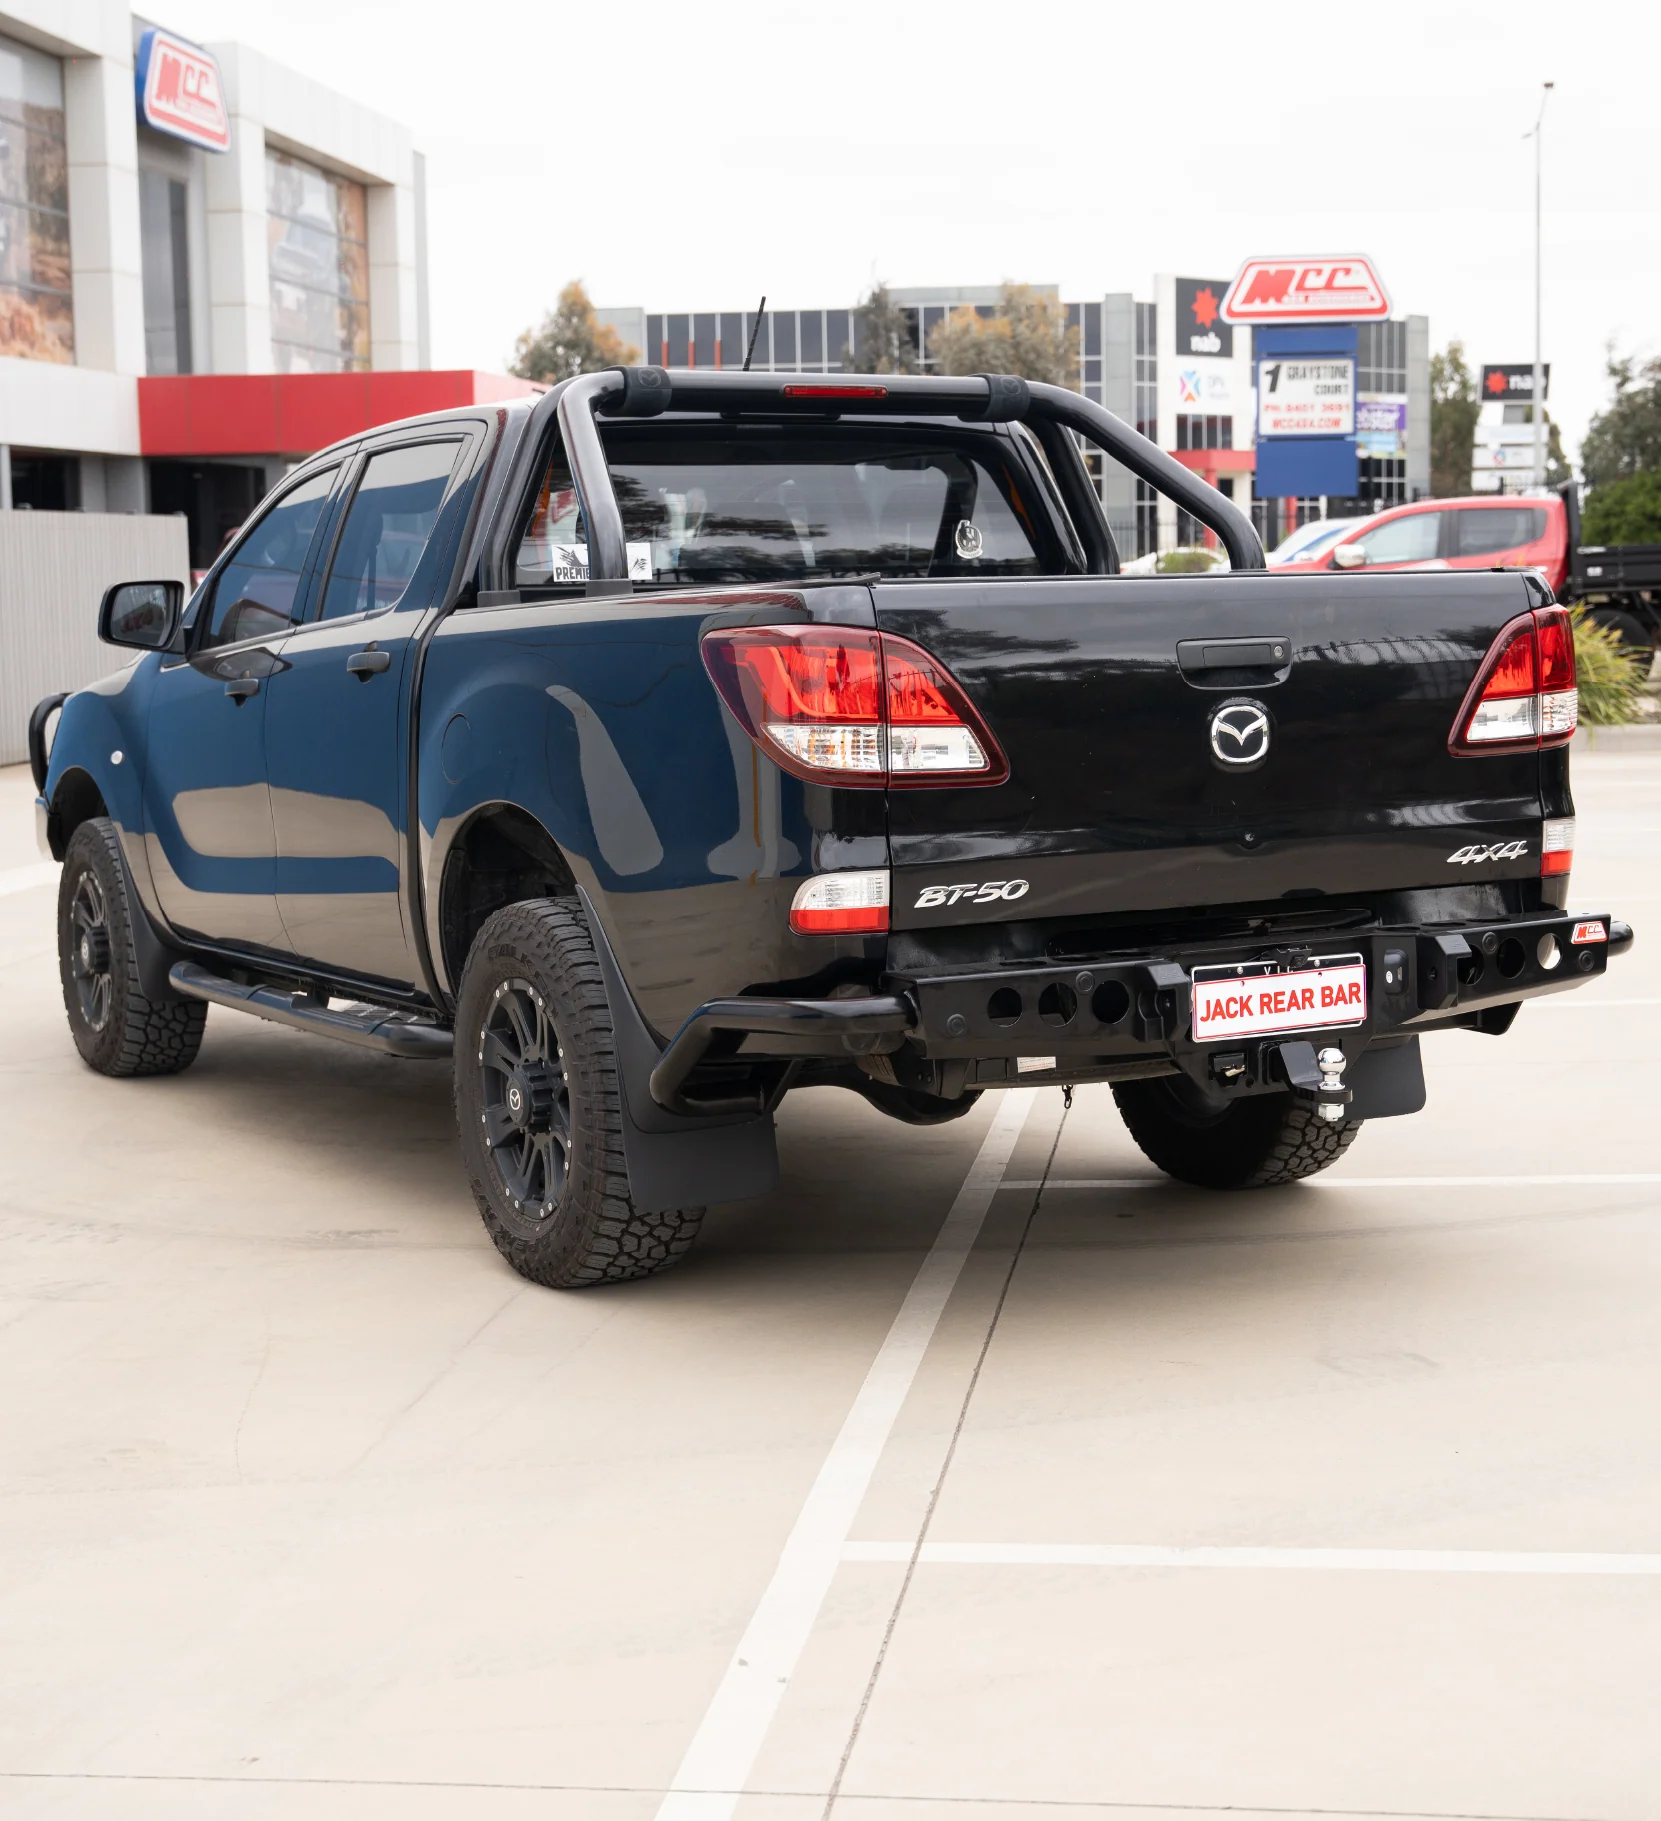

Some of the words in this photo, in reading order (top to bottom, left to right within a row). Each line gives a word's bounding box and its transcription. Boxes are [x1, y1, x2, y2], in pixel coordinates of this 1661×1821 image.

[155, 52, 216, 108] MCC
[1240, 267, 1368, 305] MCC
[1190, 331, 1221, 353] nab
[1265, 364, 1281, 393] 1
[1287, 365, 1349, 380] GRAYSTONE
[1314, 384, 1349, 396] COURT
[1509, 373, 1547, 390] na
[914, 879, 1030, 908] BT-50
[1577, 924, 1603, 940] MCC
[1200, 995, 1254, 1022] JACK
[1260, 988, 1315, 1015] REAR
[1321, 982, 1362, 1008] BAR
